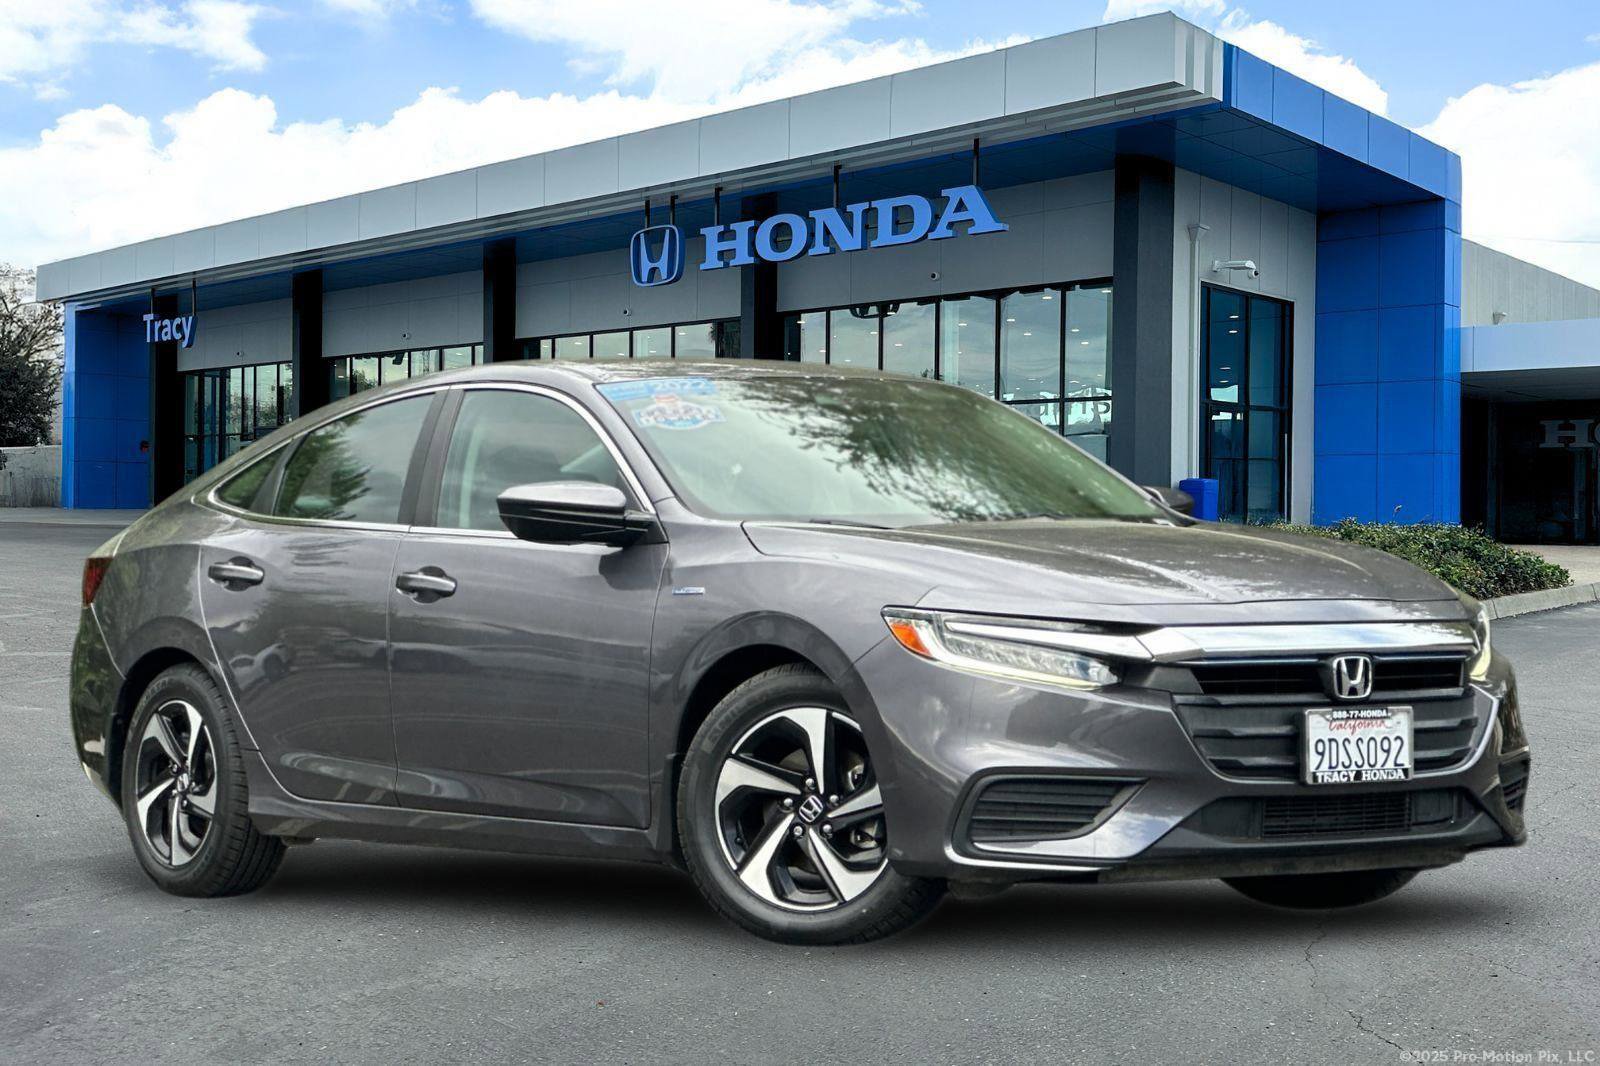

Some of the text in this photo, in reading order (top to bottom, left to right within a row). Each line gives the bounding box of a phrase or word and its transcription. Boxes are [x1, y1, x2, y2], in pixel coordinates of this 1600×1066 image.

[700, 184, 1009, 270] HONDA
[143, 313, 195, 348] Tracy
[1539, 418, 1600, 448] H
[1328, 719, 1391, 736] California
[1314, 735, 1406, 771] 9DSS092
[1315, 768, 1406, 783] TRACY HONDA
